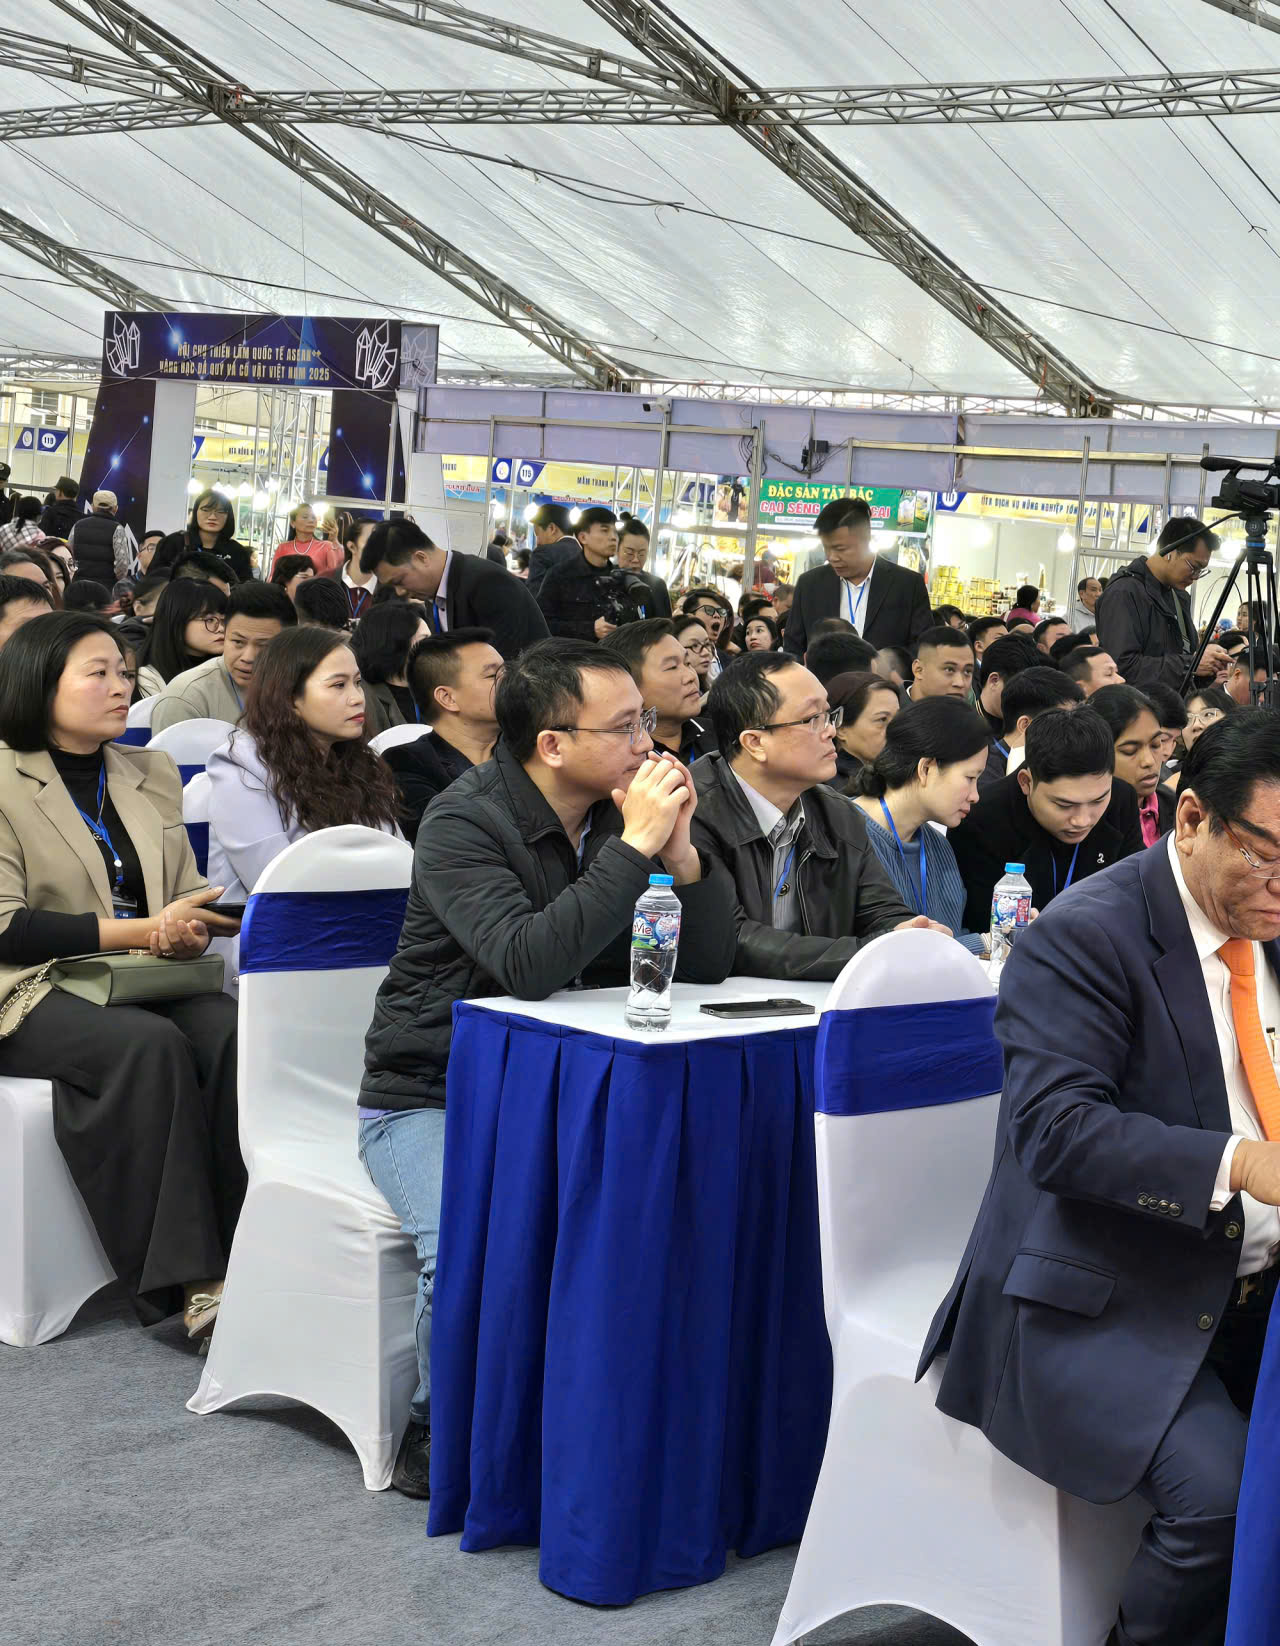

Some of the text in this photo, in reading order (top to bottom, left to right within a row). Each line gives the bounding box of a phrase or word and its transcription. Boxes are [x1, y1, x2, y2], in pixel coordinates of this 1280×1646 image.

[252, 345, 272, 360] QUỐC
[275, 346, 285, 361] TẾ
[252, 362, 267, 380] VẬT
[269, 363, 286, 381] VIỆT
[288, 366, 306, 380] NAM
[308, 367, 330, 381] 2025
[521, 469, 532, 478] 115
[768, 483, 793, 500] ĐẶC
[796, 483, 819, 499] SẢN
[760, 501, 784, 516] GẠO
[787, 501, 821, 515] SÉNG
